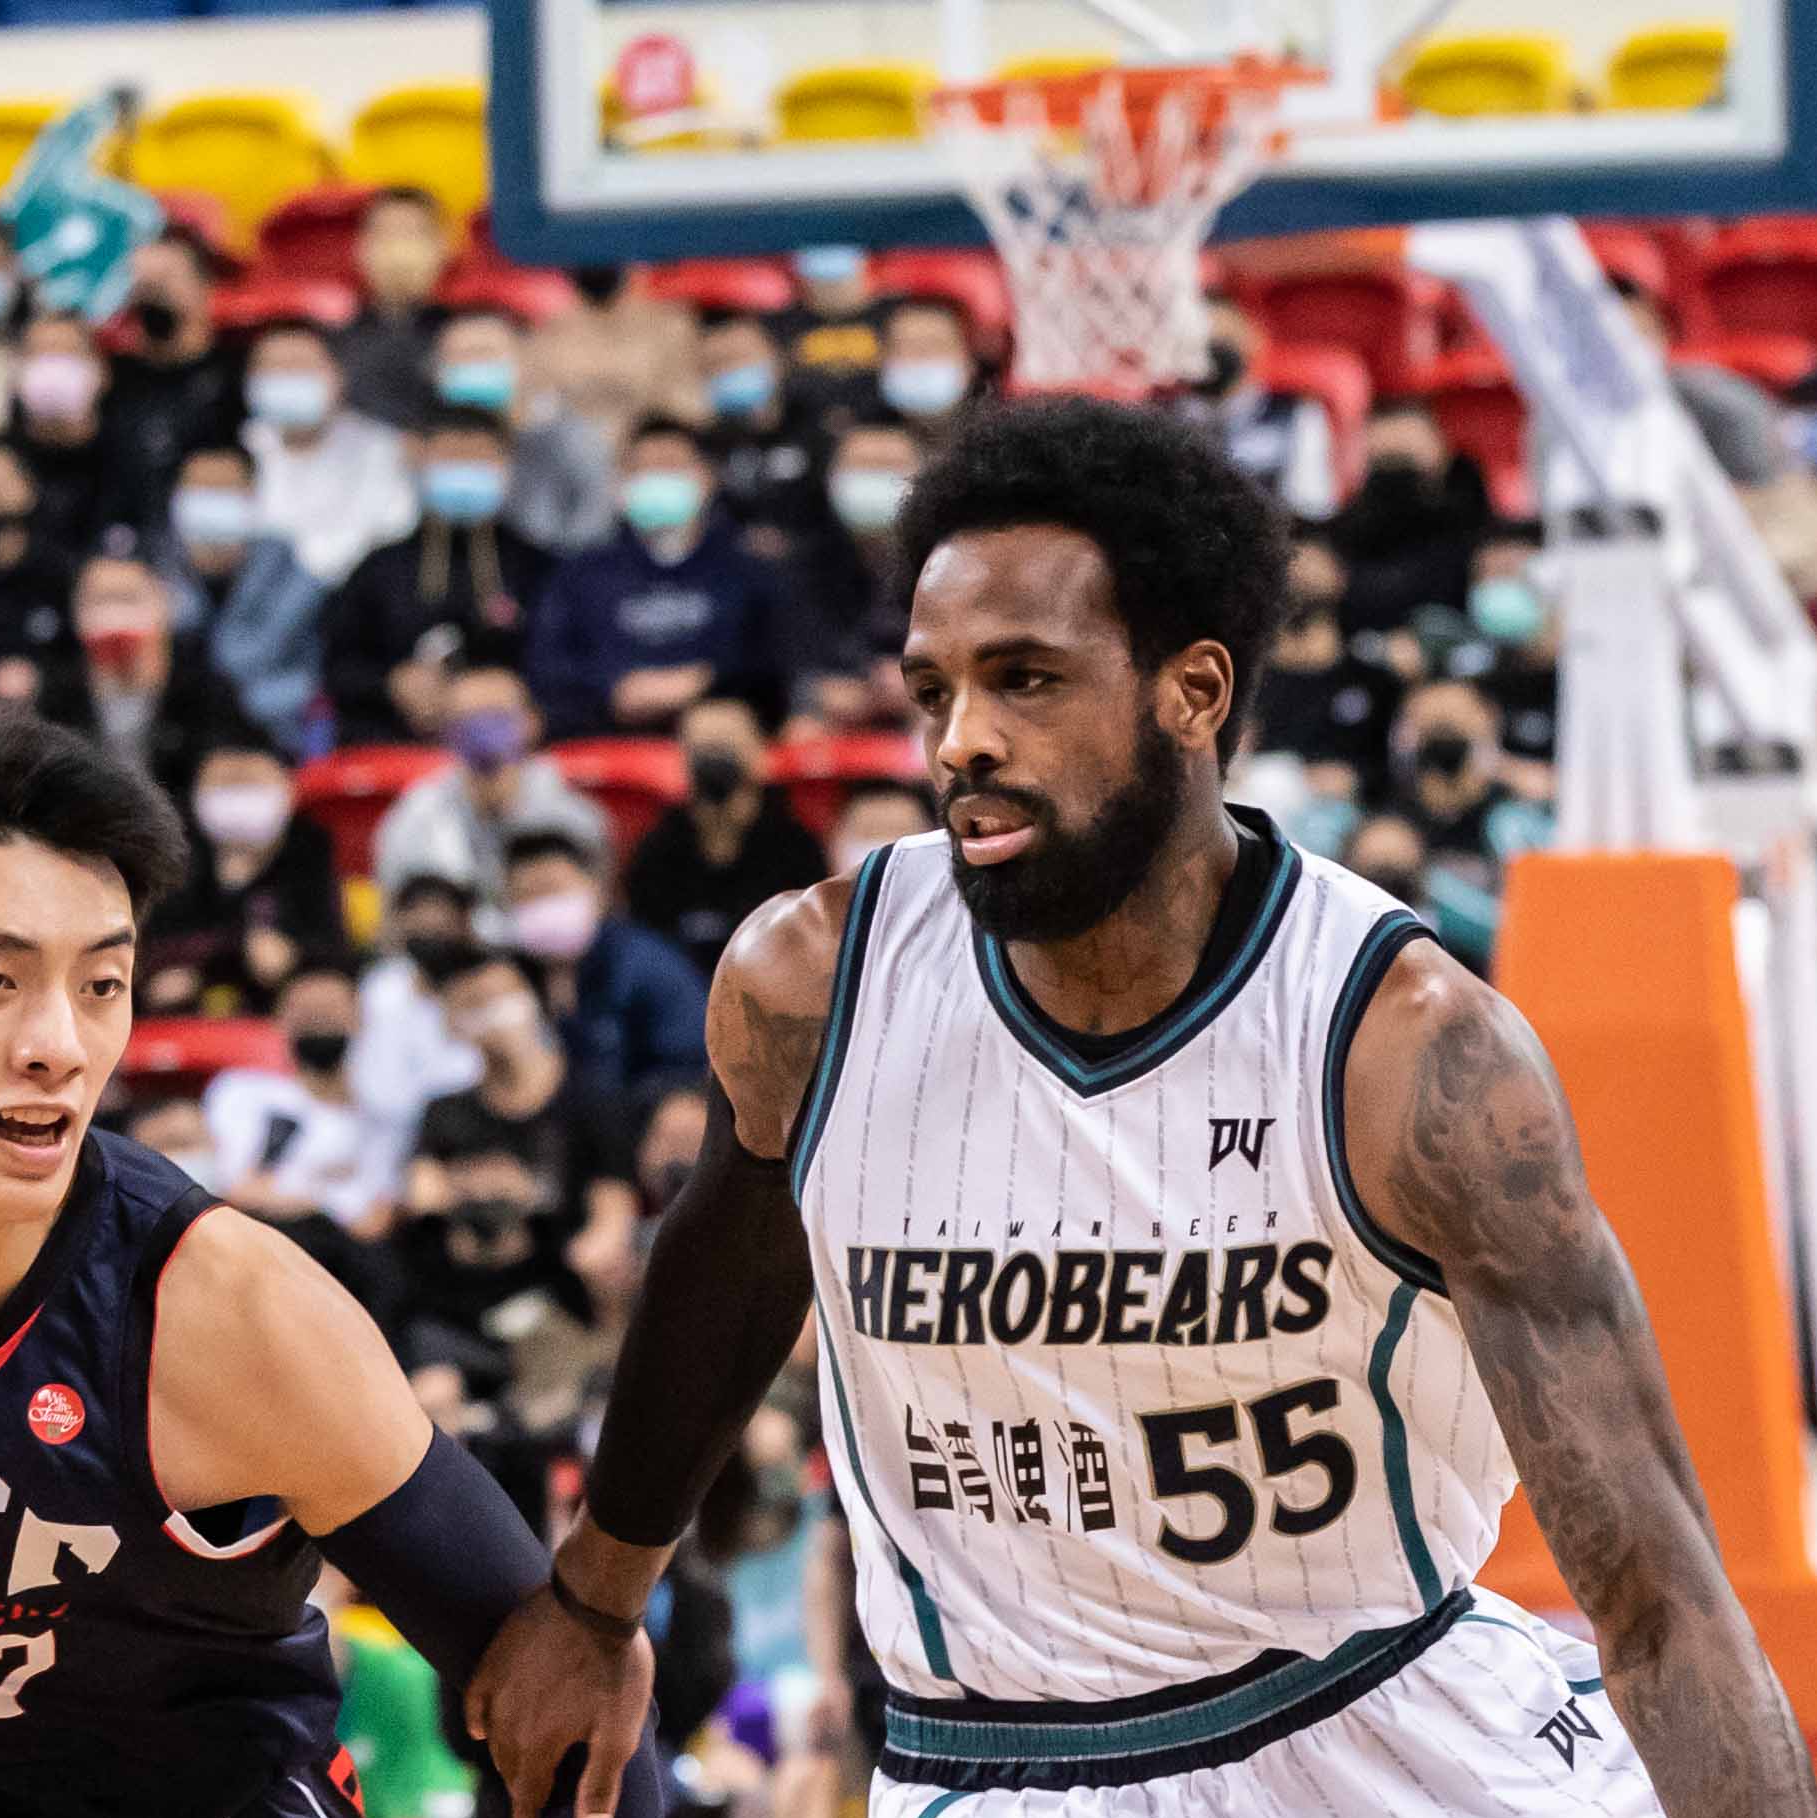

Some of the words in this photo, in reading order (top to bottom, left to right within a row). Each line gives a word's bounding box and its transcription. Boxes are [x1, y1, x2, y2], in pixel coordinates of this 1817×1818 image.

[903, 1217, 1102, 1238] TAIWAN
[1151, 1211, 1278, 1238] BEER
[846, 1242, 1333, 1346] HEROBEARS
[1134, 1378, 1357, 1564] 55
